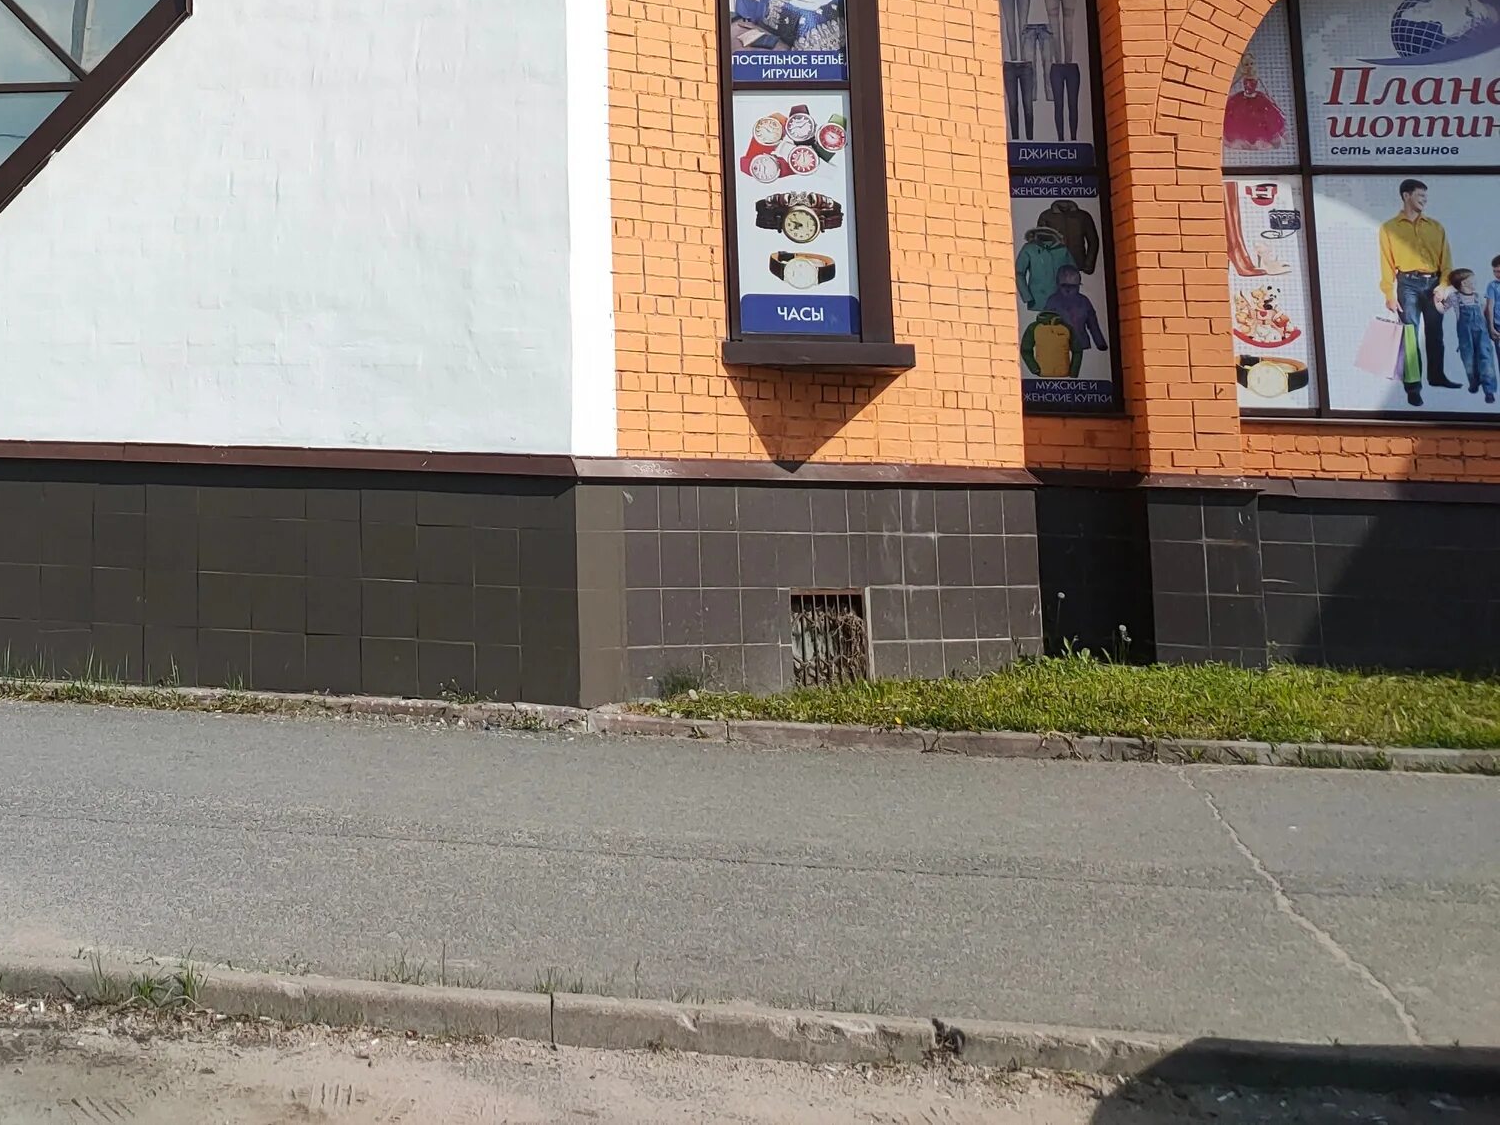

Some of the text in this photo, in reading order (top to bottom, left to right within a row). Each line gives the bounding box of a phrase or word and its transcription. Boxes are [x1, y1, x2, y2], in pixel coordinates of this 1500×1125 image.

[731, 54, 808, 66] ПОСТЕЛЬНОЕ
[762, 68, 818, 79] ИГРУШКИ
[1018, 148, 1077, 161] ДЖИНСЫ
[1331, 146, 1459, 155] сеть магазинов
[1024, 175, 1083, 185] МУЖСКИЕ И
[1012, 186, 1097, 196] ЖЕНСКИЕ КУРТКИ
[777, 307, 824, 322] ЧАСЫ
[1036, 380, 1098, 391] МУЖСКИЕ И
[1024, 393, 1113, 403] ЖЕНСКИЕ КУРТКИ
